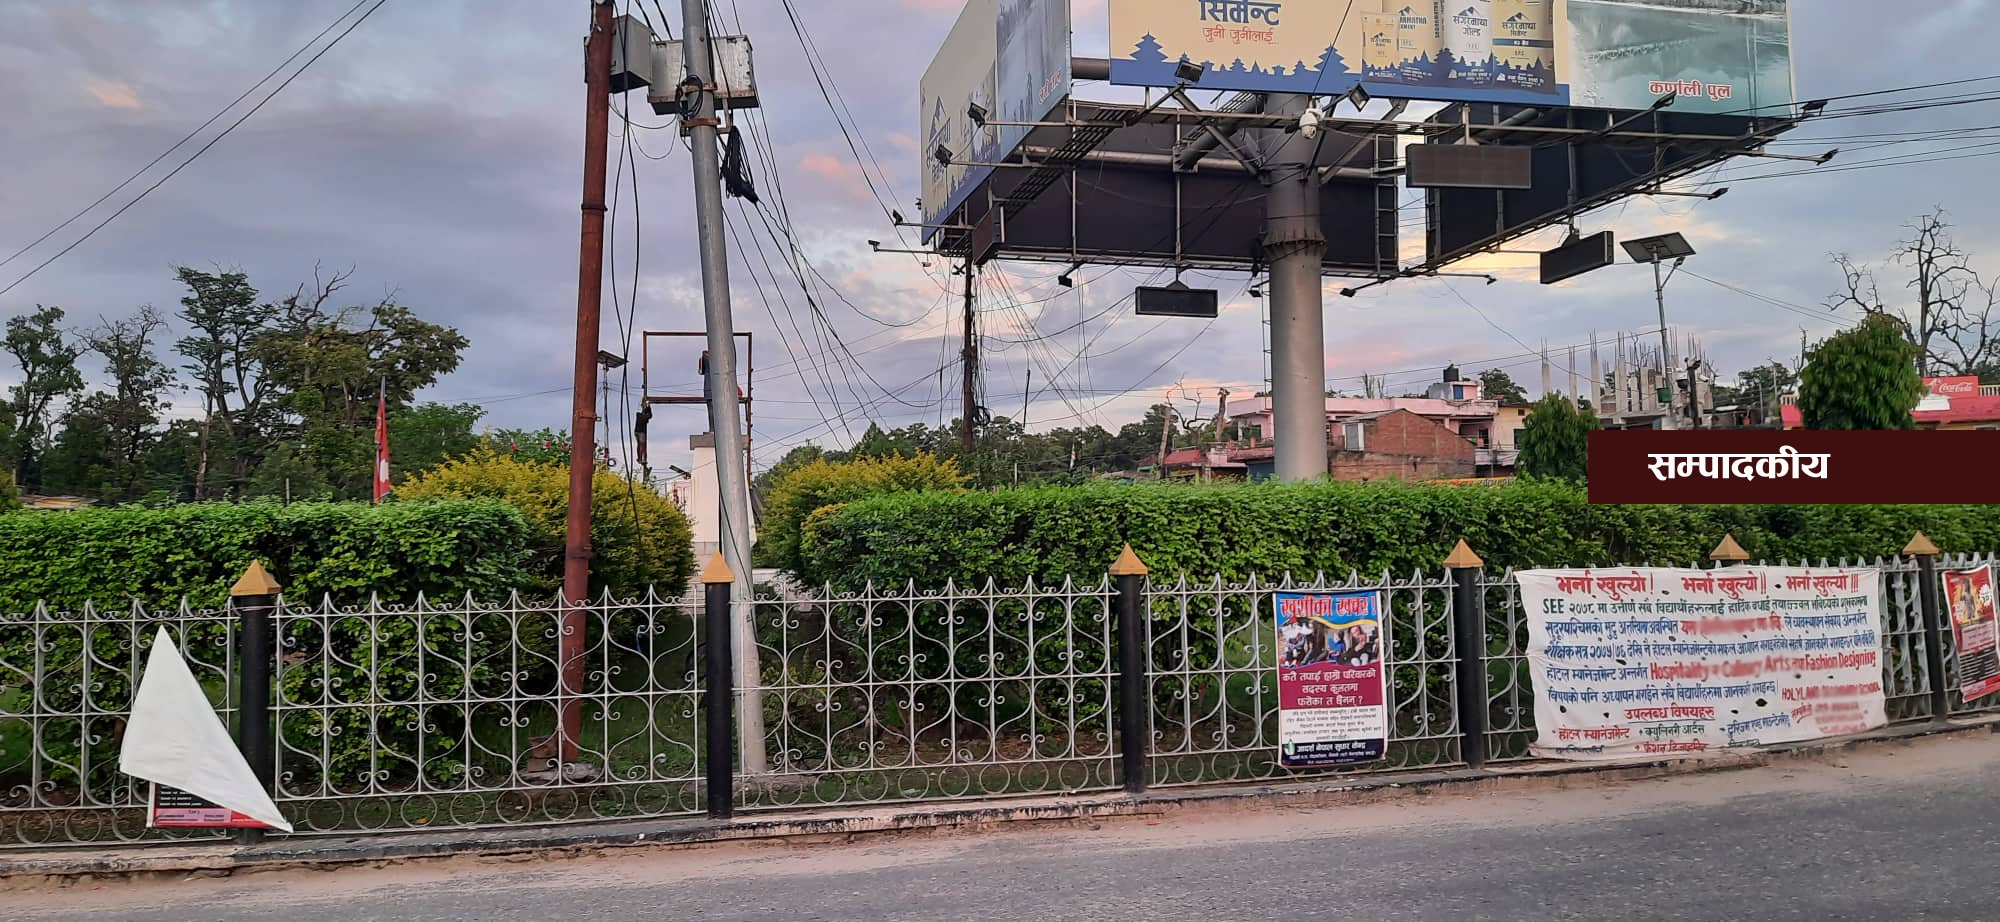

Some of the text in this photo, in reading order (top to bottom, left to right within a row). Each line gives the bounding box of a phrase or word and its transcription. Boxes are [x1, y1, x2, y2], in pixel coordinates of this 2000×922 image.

[1203, 24, 1225, 43] जुनी
[1706, 83, 1731, 101] पुल
[1556, 569, 1594, 596] भर्ना
[1597, 571, 1647, 601] खुल्यो
[1681, 571, 1714, 595] भर्ना
[1717, 571, 1758, 600] खुल्यो
[1786, 570, 1811, 593] भर्ना
[1813, 570, 1848, 597] खुल्यो
[1543, 598, 1564, 614] SEE
[1597, 602, 1608, 614] मा
[1765, 655, 1791, 673] Arts
[1805, 653, 1837, 671] Fashion
[1839, 649, 1876, 671] Designing
[1624, 708, 1668, 721] उपलब्ध
